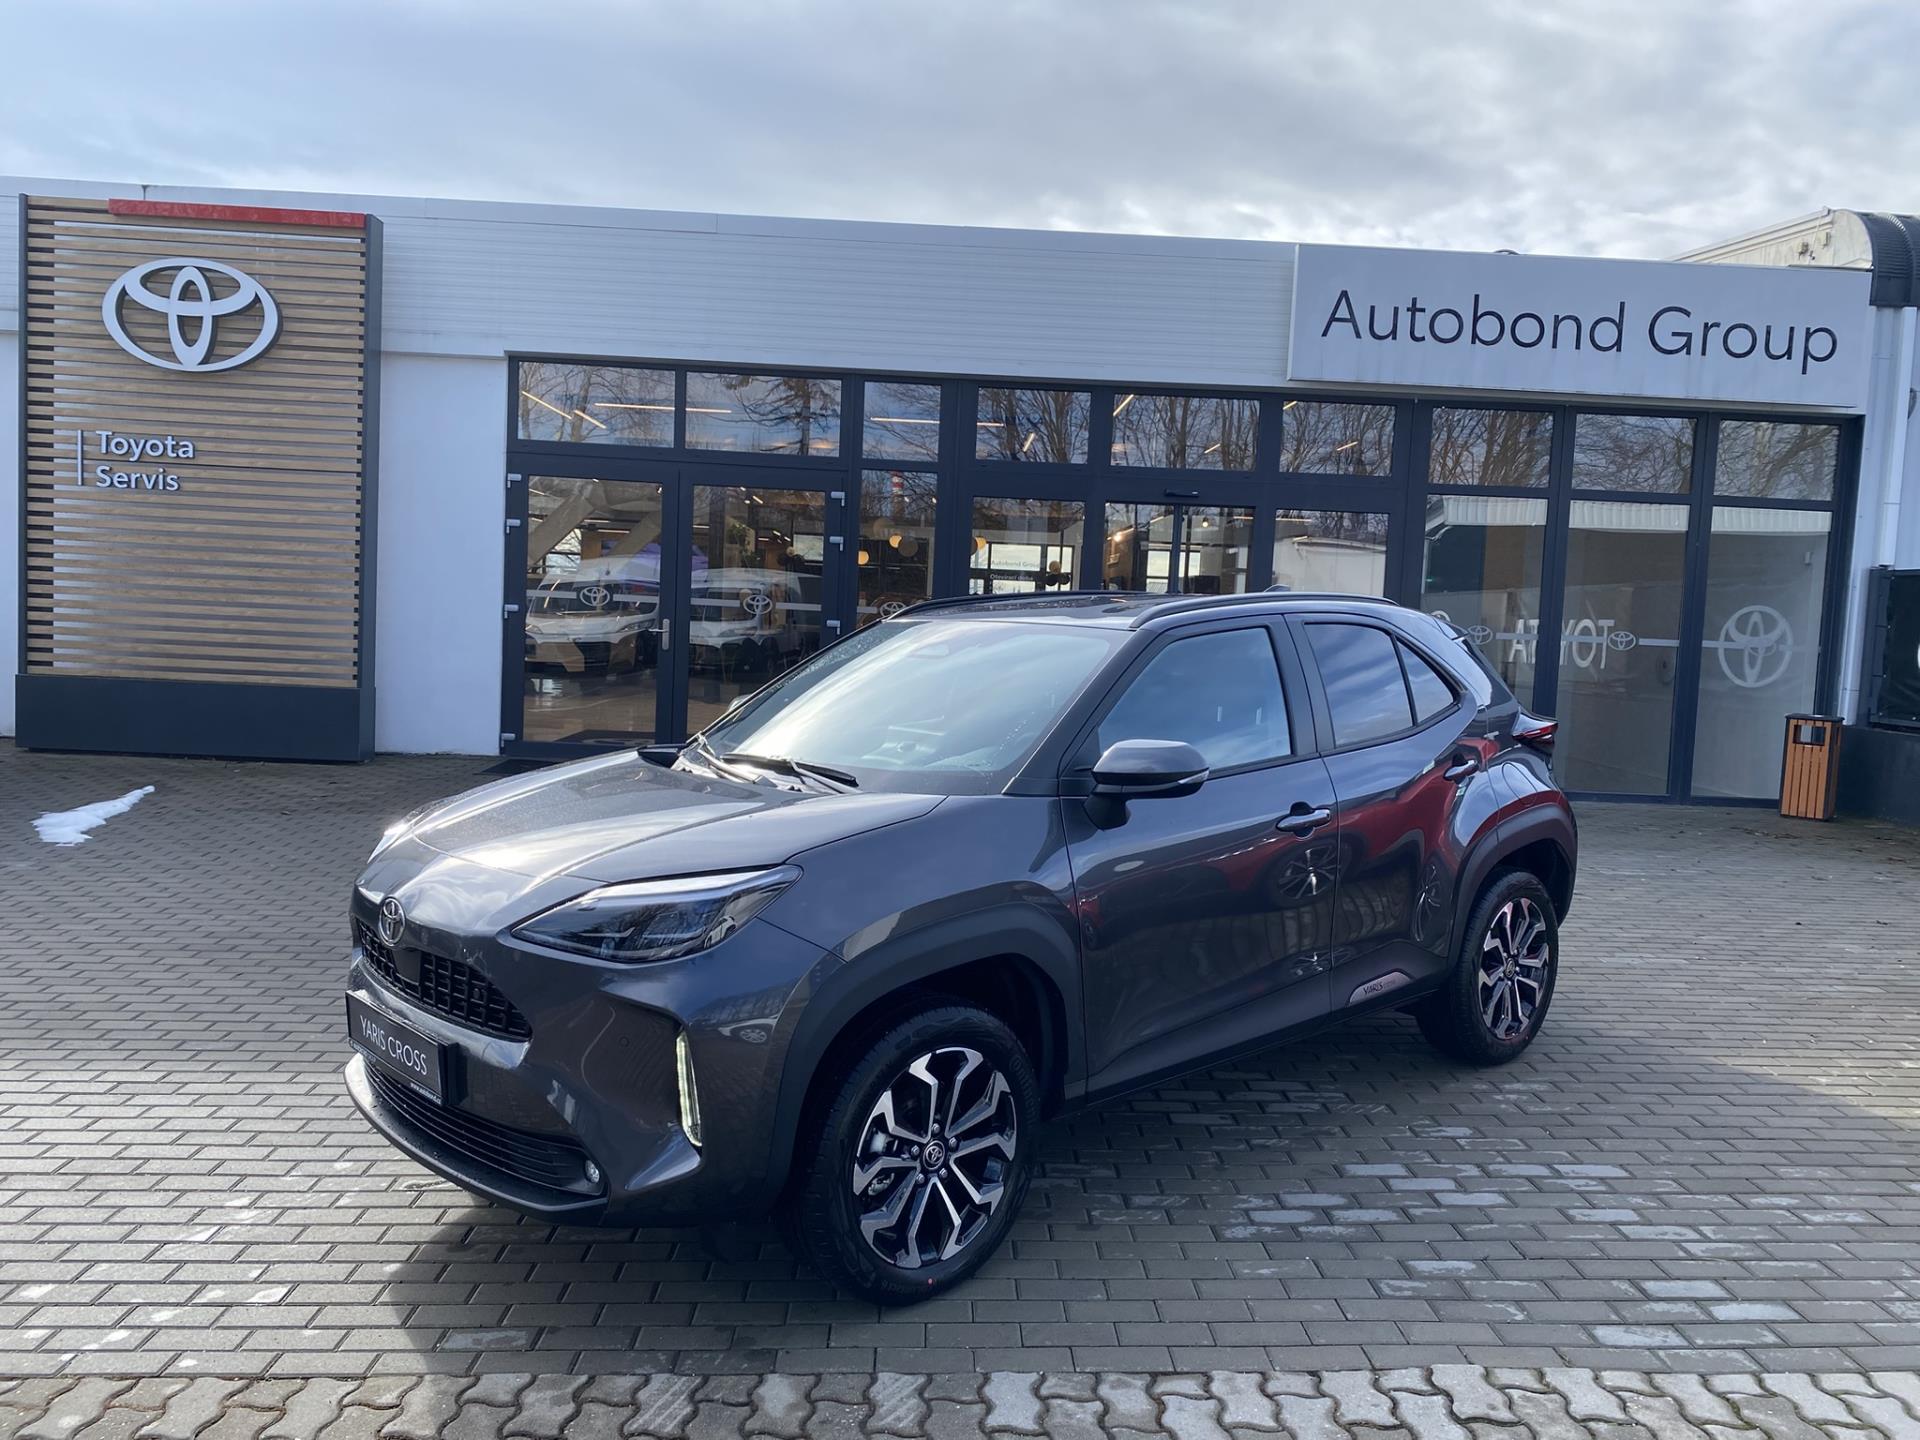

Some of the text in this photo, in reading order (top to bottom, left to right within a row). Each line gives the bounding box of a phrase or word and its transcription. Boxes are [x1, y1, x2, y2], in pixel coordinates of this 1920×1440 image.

[1321, 289, 1839, 376] Autobond Group
[95, 430, 195, 462] Toyota
[95, 465, 179, 491] Servis
[360, 1014, 386, 1051] YARIS
[387, 1036, 428, 1076] CROSS
